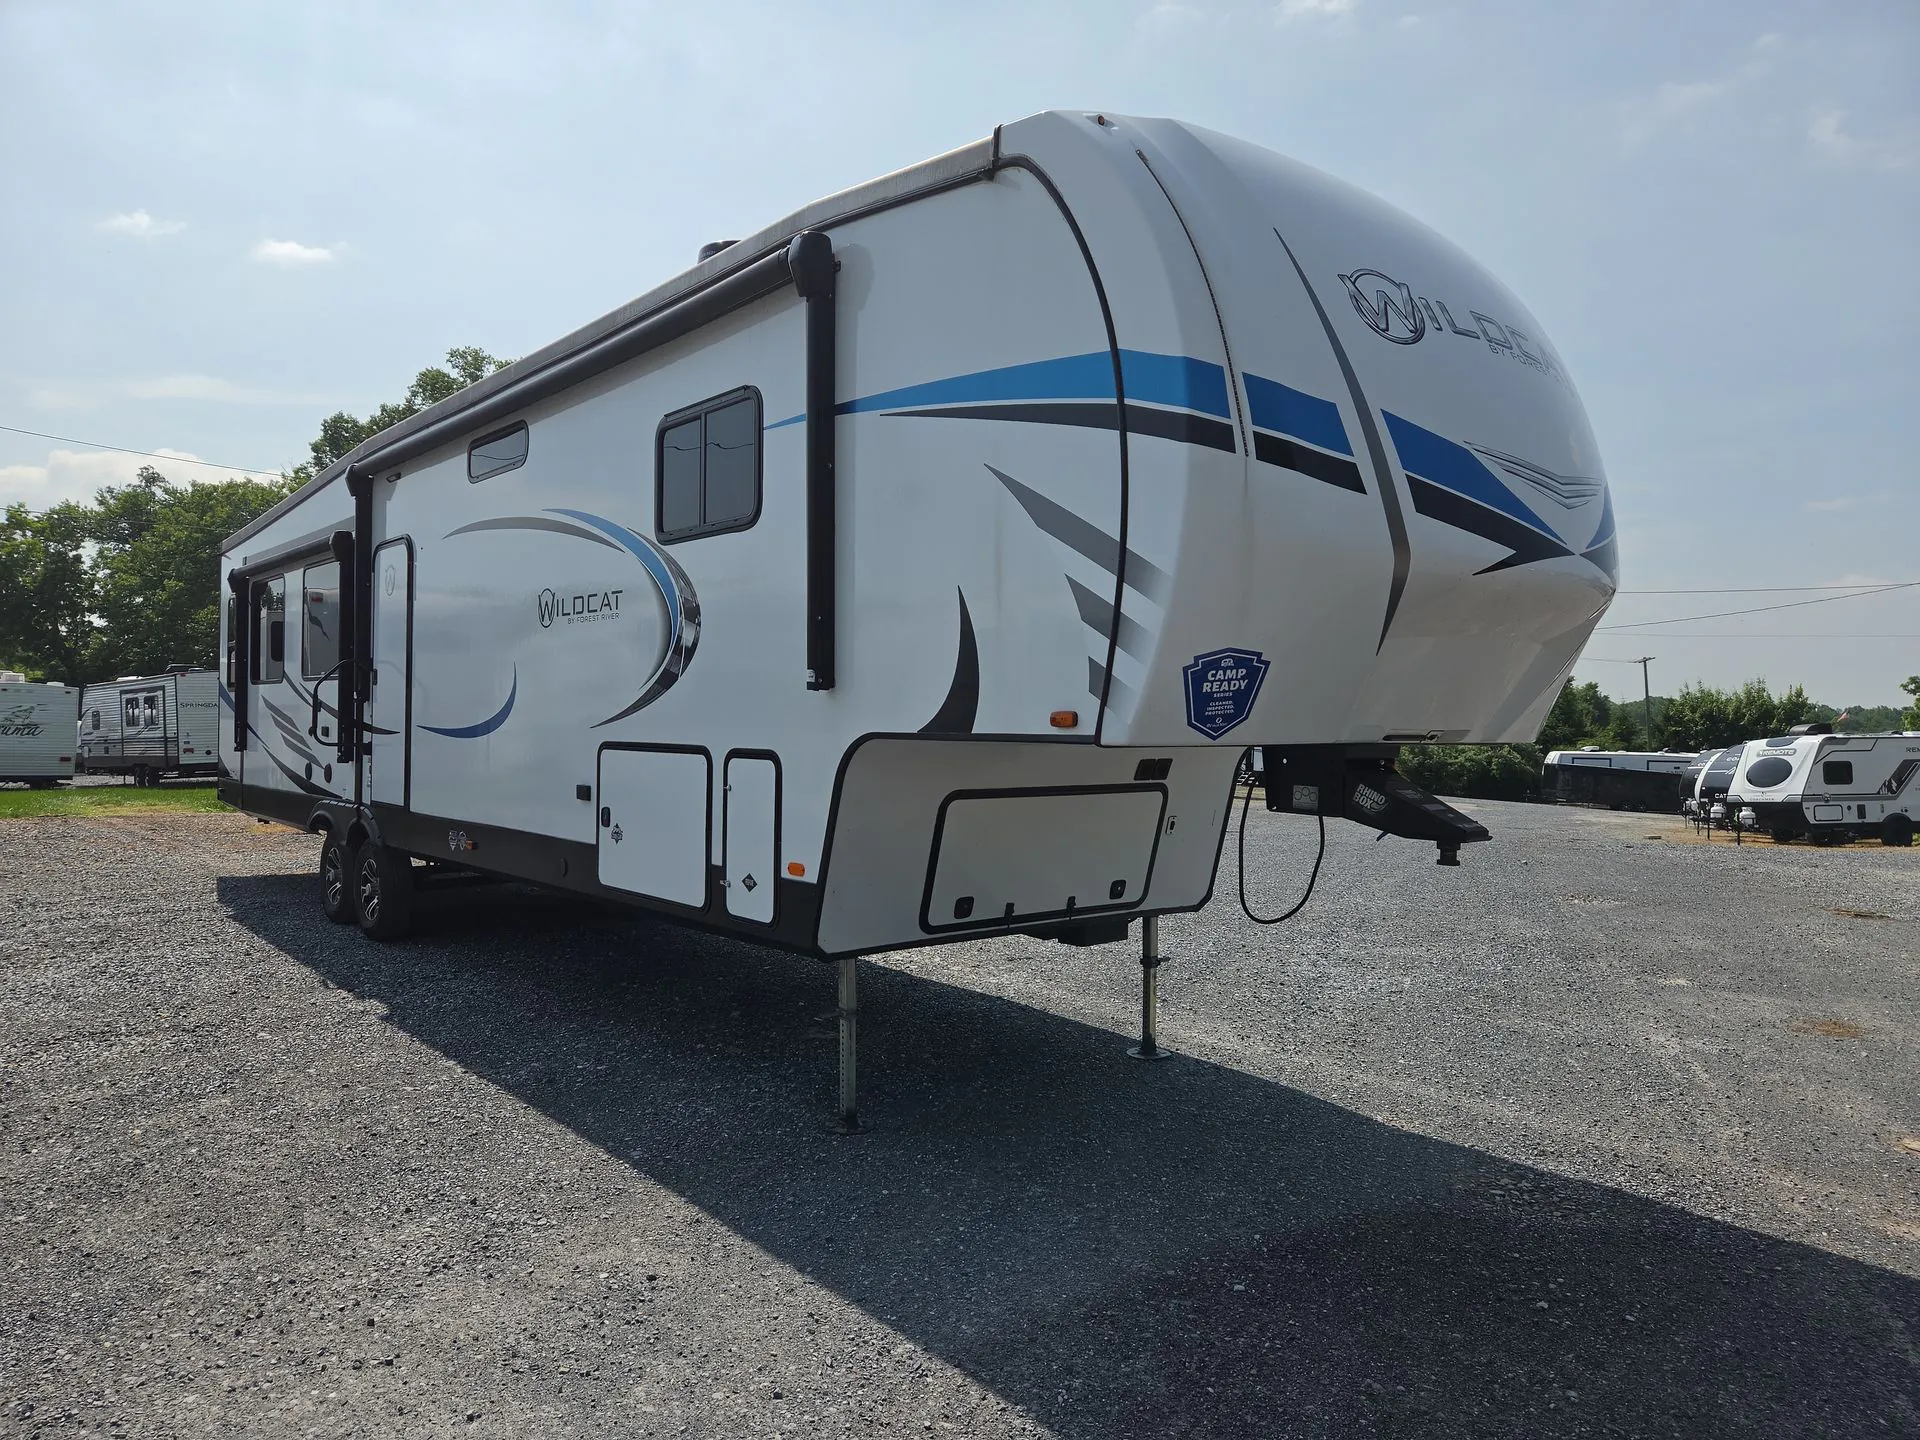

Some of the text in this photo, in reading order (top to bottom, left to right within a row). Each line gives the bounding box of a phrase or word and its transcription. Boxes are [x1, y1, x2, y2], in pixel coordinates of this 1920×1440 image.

[1488, 343, 1505, 357] BY
[538, 588, 623, 628] WILDCAT
[567, 612, 620, 625] BY FOREST RIVER
[1207, 668, 1247, 681] CAMP
[1202, 679, 1249, 693] READY
[1353, 791, 1373, 809] BOX
[1356, 783, 1386, 805] RHINO
